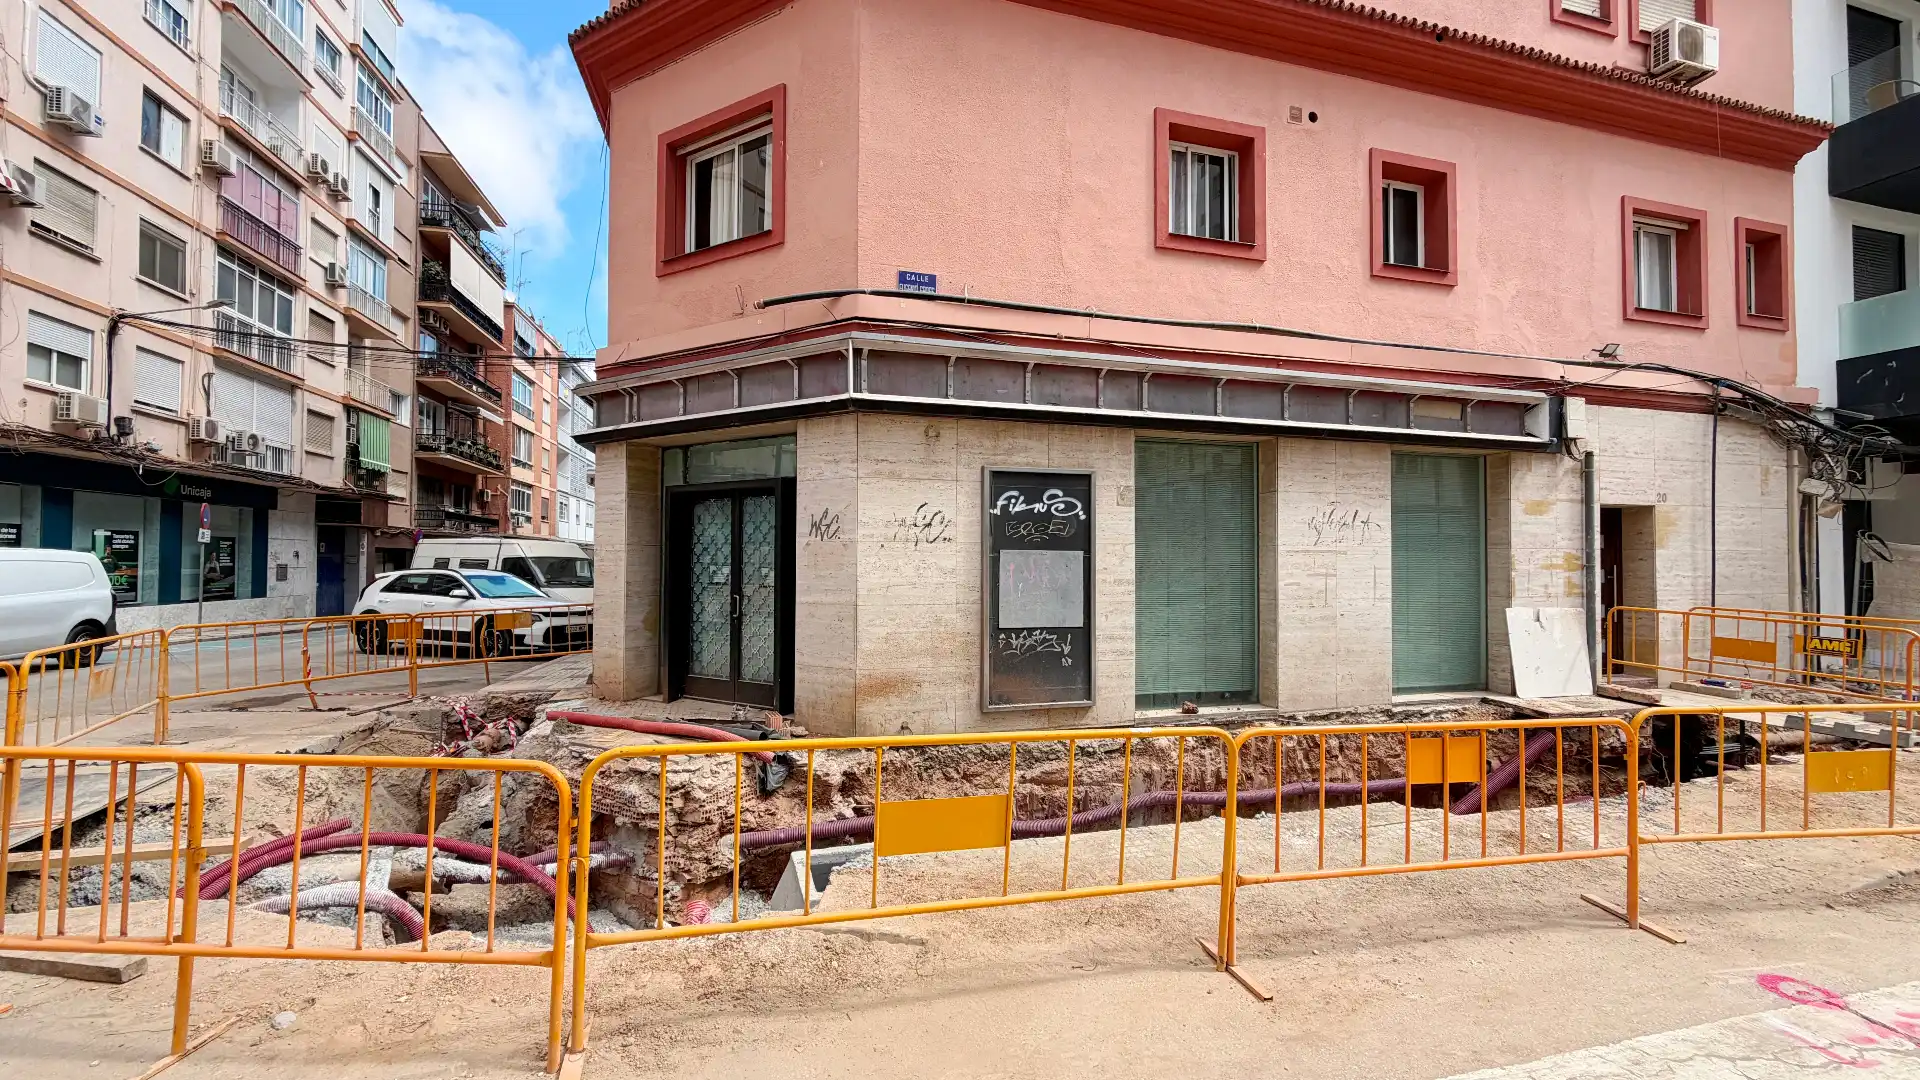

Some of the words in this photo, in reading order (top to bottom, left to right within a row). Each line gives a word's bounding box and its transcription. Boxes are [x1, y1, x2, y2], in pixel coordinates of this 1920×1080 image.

[906, 273, 929, 283] CALLE
[180, 484, 212, 500] Unicaja
[1656, 492, 1667, 503] 20
